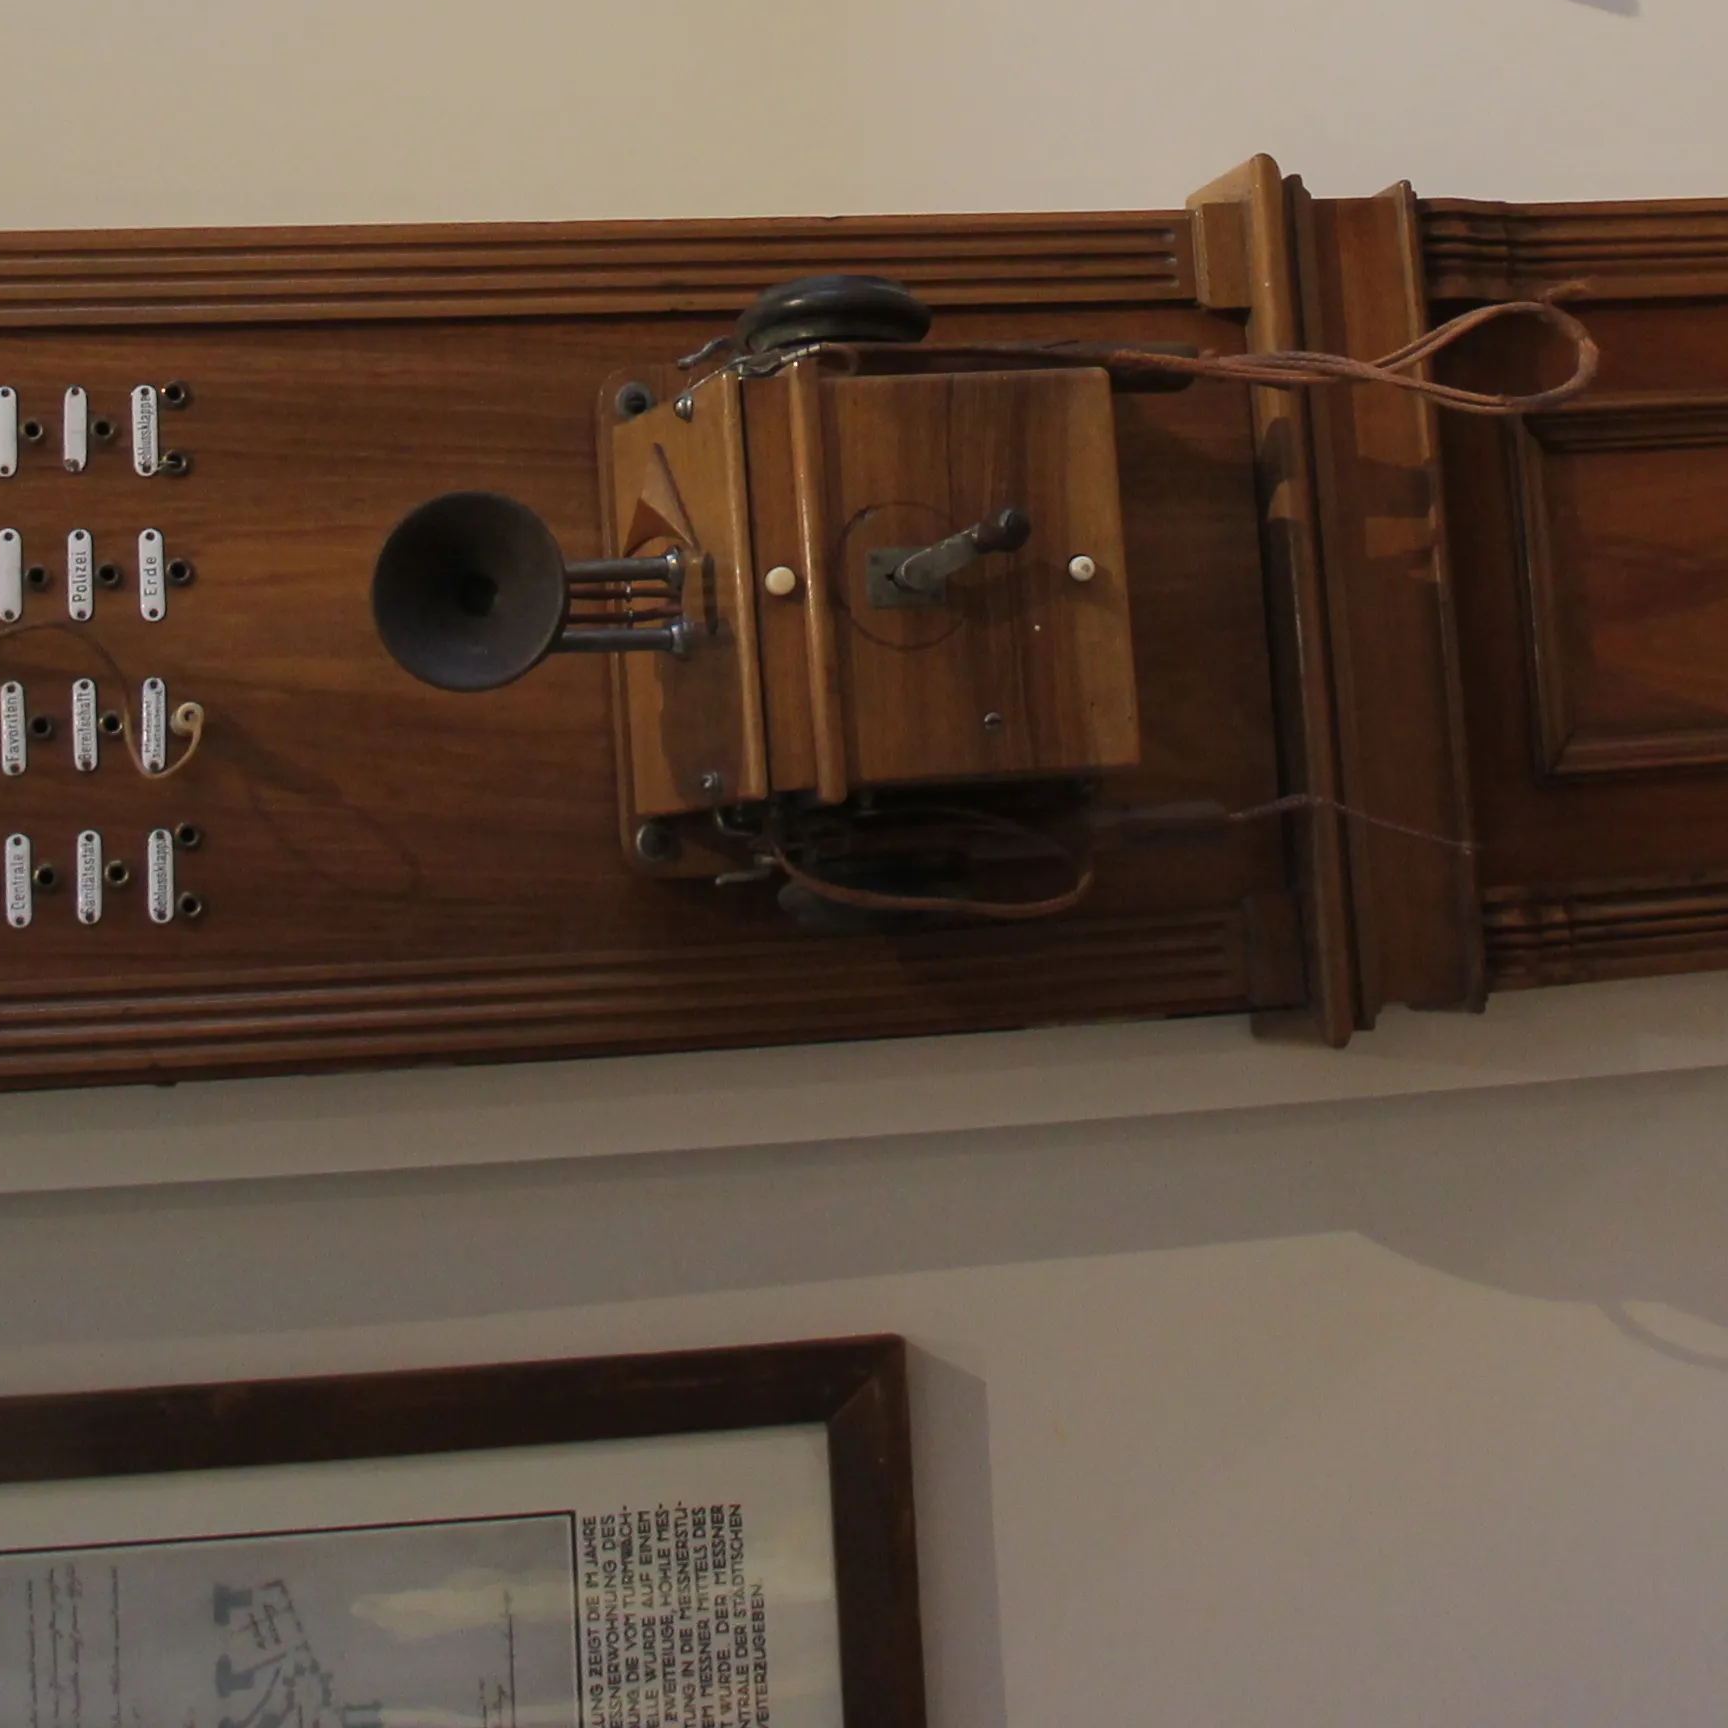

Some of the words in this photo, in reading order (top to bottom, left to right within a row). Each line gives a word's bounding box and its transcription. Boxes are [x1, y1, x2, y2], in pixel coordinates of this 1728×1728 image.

[72, 550, 88, 603] Polizei
[144, 556, 158, 597] Erde
[5, 696, 20, 763] Favoriten
[76, 692, 92, 762] Bereitschaft
[10, 854, 25, 910] Centrale
[582, 1515, 599, 1568] JAHRE
[600, 1514, 616, 1551] DES
[637, 1510, 653, 1566] EINEM
[654, 1503, 670, 1542] MES-
[692, 1505, 708, 1538] DES
[674, 1500, 692, 1620] MESSNERSTU-
[710, 1504, 728, 1585] MESSNER
[584, 1572, 599, 1588] IM
[639, 1572, 654, 1609] AUF
[693, 1544, 711, 1612] MITTELS
[585, 1595, 601, 1622] DIE
[714, 1594, 730, 1635] DER
[622, 1613, 638, 1651] VOM
[641, 1616, 658, 1683] WURDE
[678, 1628, 694, 1654] DIE
[733, 1624, 749, 1659] DER
[586, 1628, 604, 1678] ZEIGT
[625, 1657, 640, 1683] DIE
[680, 1660, 696, 1677] IN
[697, 1618, 714, 1698] MESSNER
